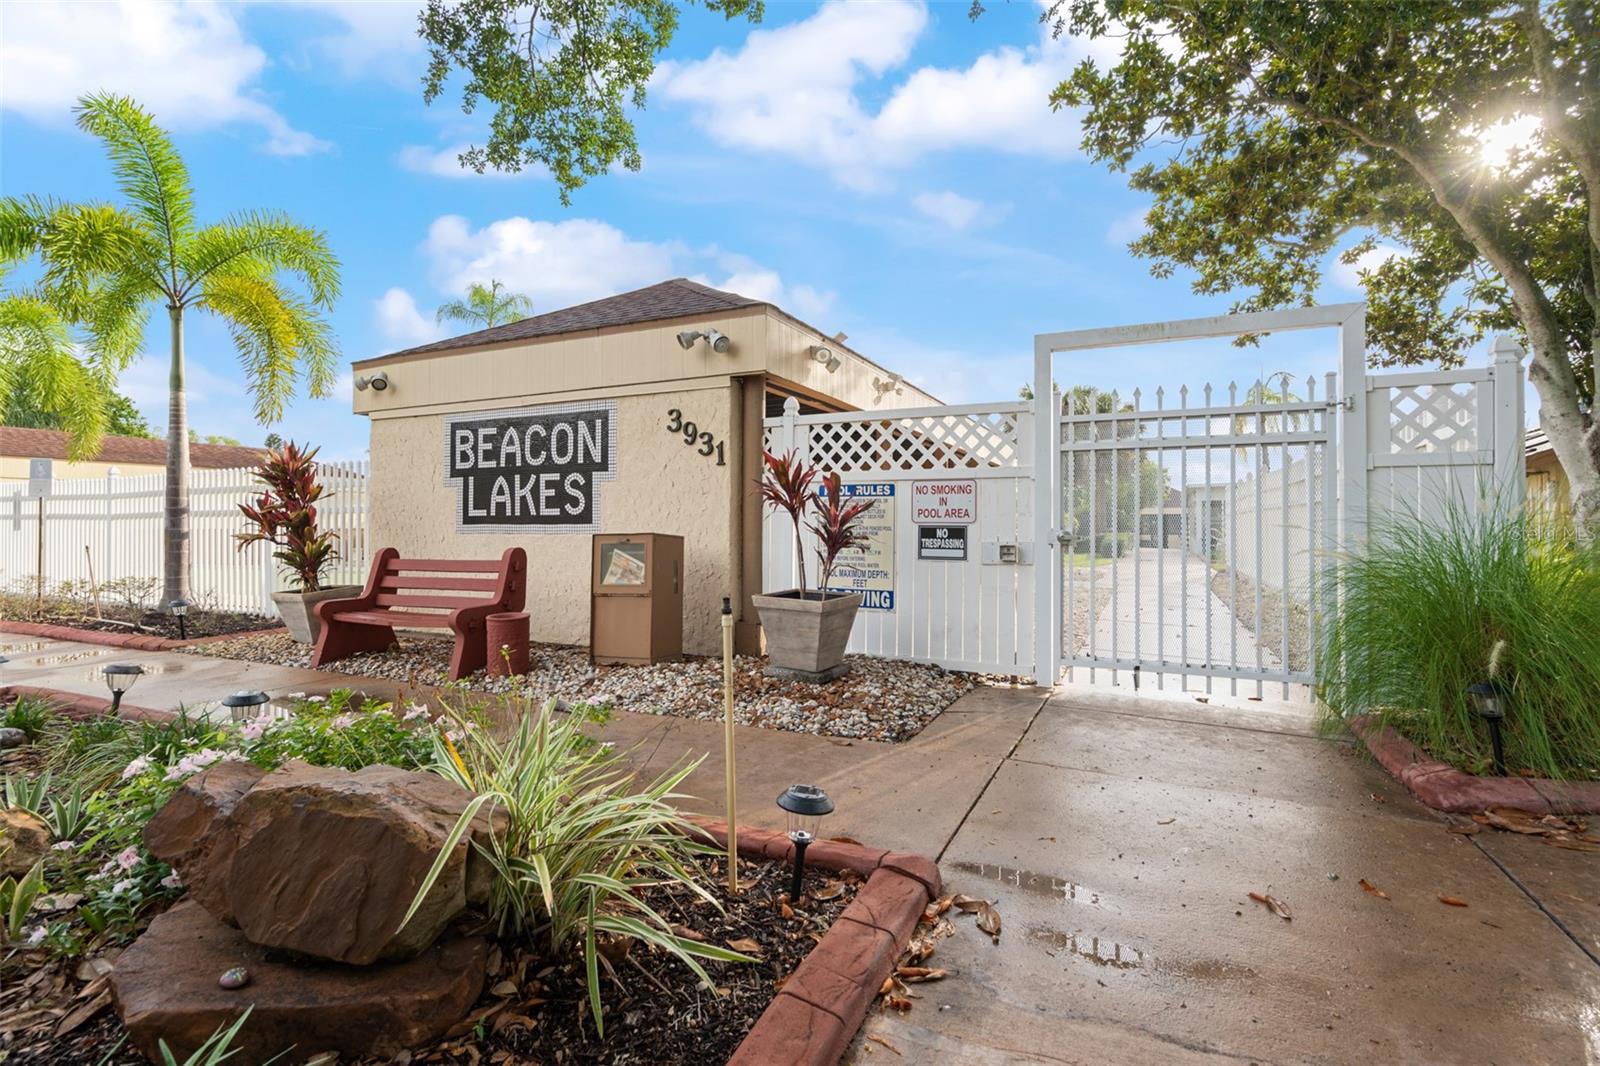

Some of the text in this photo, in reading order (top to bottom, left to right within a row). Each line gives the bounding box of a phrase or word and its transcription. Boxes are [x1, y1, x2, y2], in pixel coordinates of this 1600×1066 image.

[667, 408, 726, 466] 3931
[455, 419, 602, 469] BEACON
[468, 472, 586, 516] LAKES
[824, 485, 890, 495] OL RULES
[915, 484, 972, 495] NO SMOKING
[939, 497, 948, 506] IN
[917, 508, 970, 518] POOL AREA
[936, 528, 948, 538] NO
[921, 538, 964, 549] TRESPASSING
[839, 569, 866, 578] MAXIMUM
[853, 579, 867, 588] FEET
